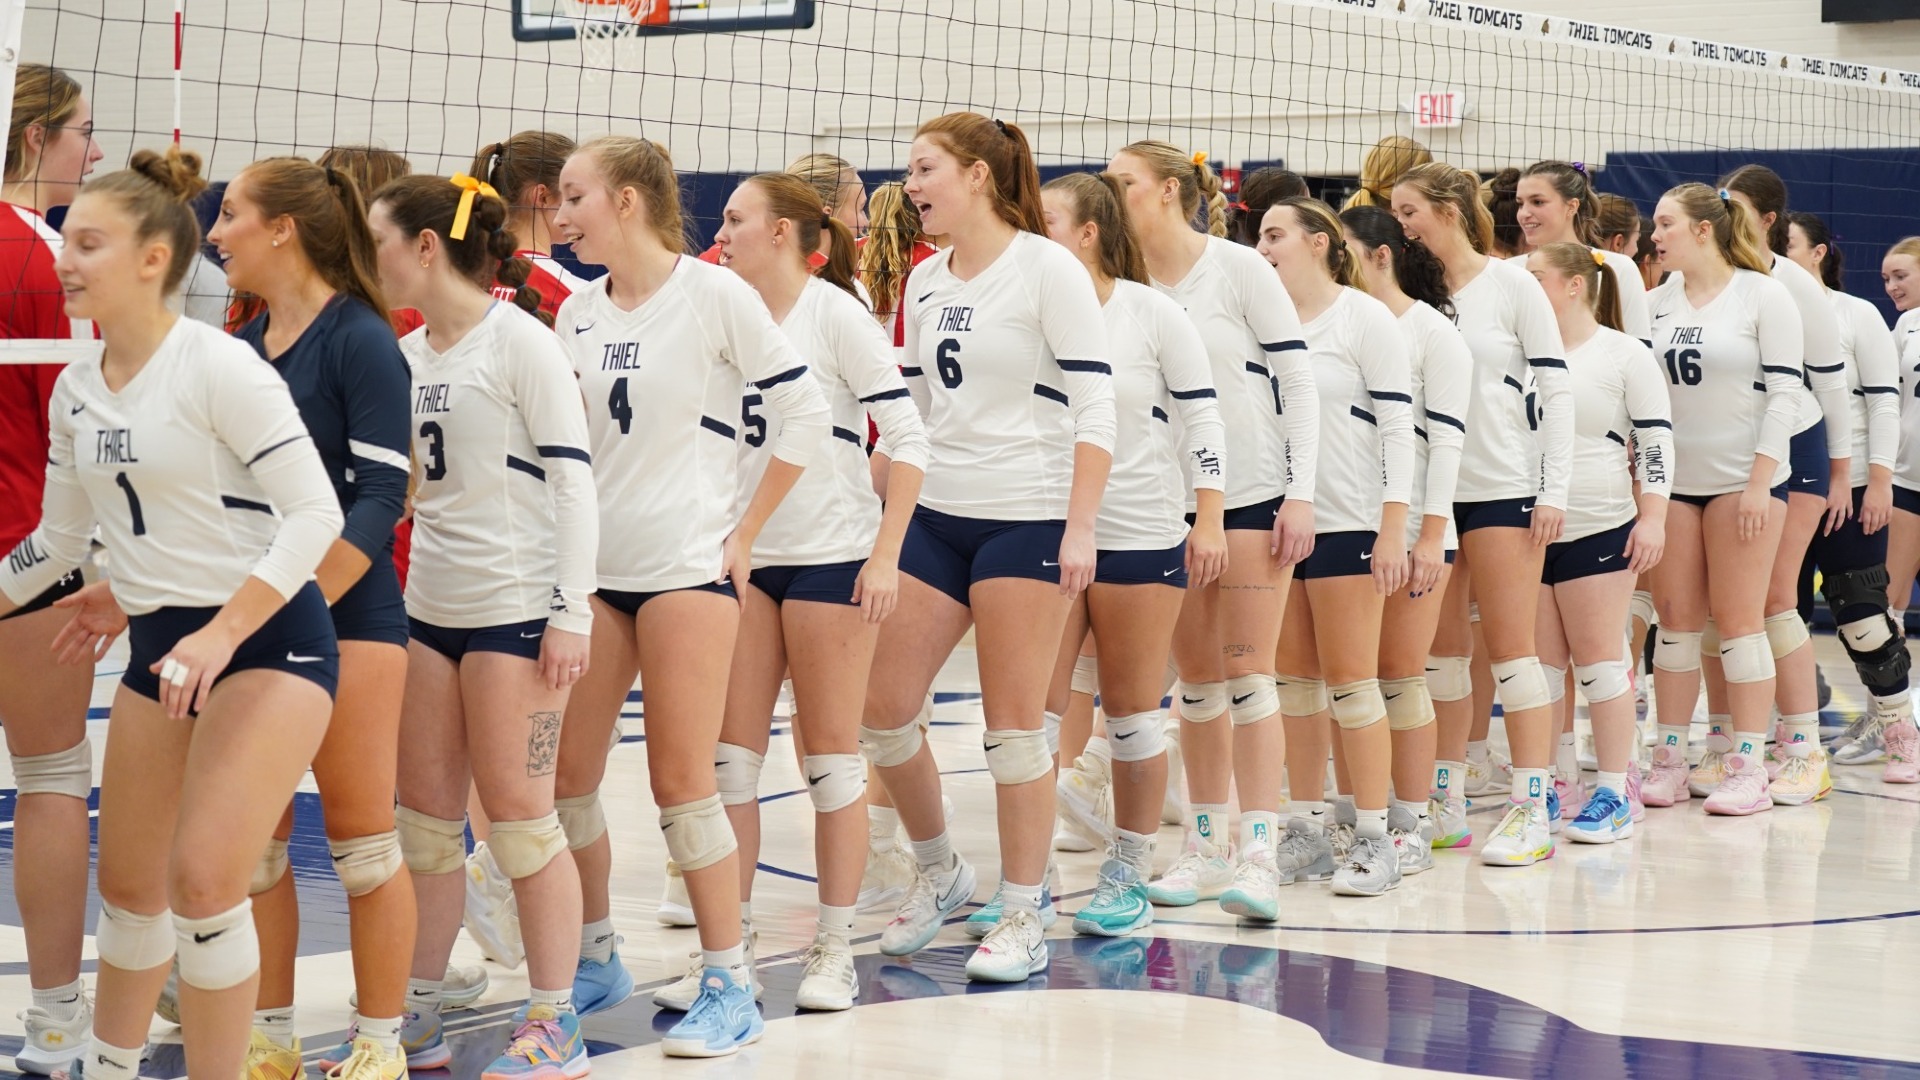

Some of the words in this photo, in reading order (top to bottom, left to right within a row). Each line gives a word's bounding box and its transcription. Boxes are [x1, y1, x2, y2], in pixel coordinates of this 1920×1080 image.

[1428, 0, 1462, 21] THIEL
[1467, 6, 1523, 31] TOMCATS
[1569, 21, 1599, 42] THIEL
[1604, 27, 1652, 50] TOMCATS
[1692, 41, 1720, 60] THIEL
[1723, 46, 1767, 68] TOMCATS
[1802, 58, 1826, 75] THIEL
[1830, 62, 1868, 81] TOMCATS
[1420, 94, 1455, 124] EXIT
[937, 306, 974, 332] THIEL
[1670, 326, 1703, 345] THIEL
[601, 342, 641, 371] THIEL
[936, 338, 963, 389] 6
[1664, 348, 1702, 386] 16
[415, 383, 450, 414] THIEL
[608, 377, 633, 435] 4
[742, 393, 767, 448] 5
[97, 428, 138, 463] THIEL
[419, 420, 447, 481] 3
[1645, 444, 1666, 484] TOMCATS
[115, 471, 146, 536] 1
